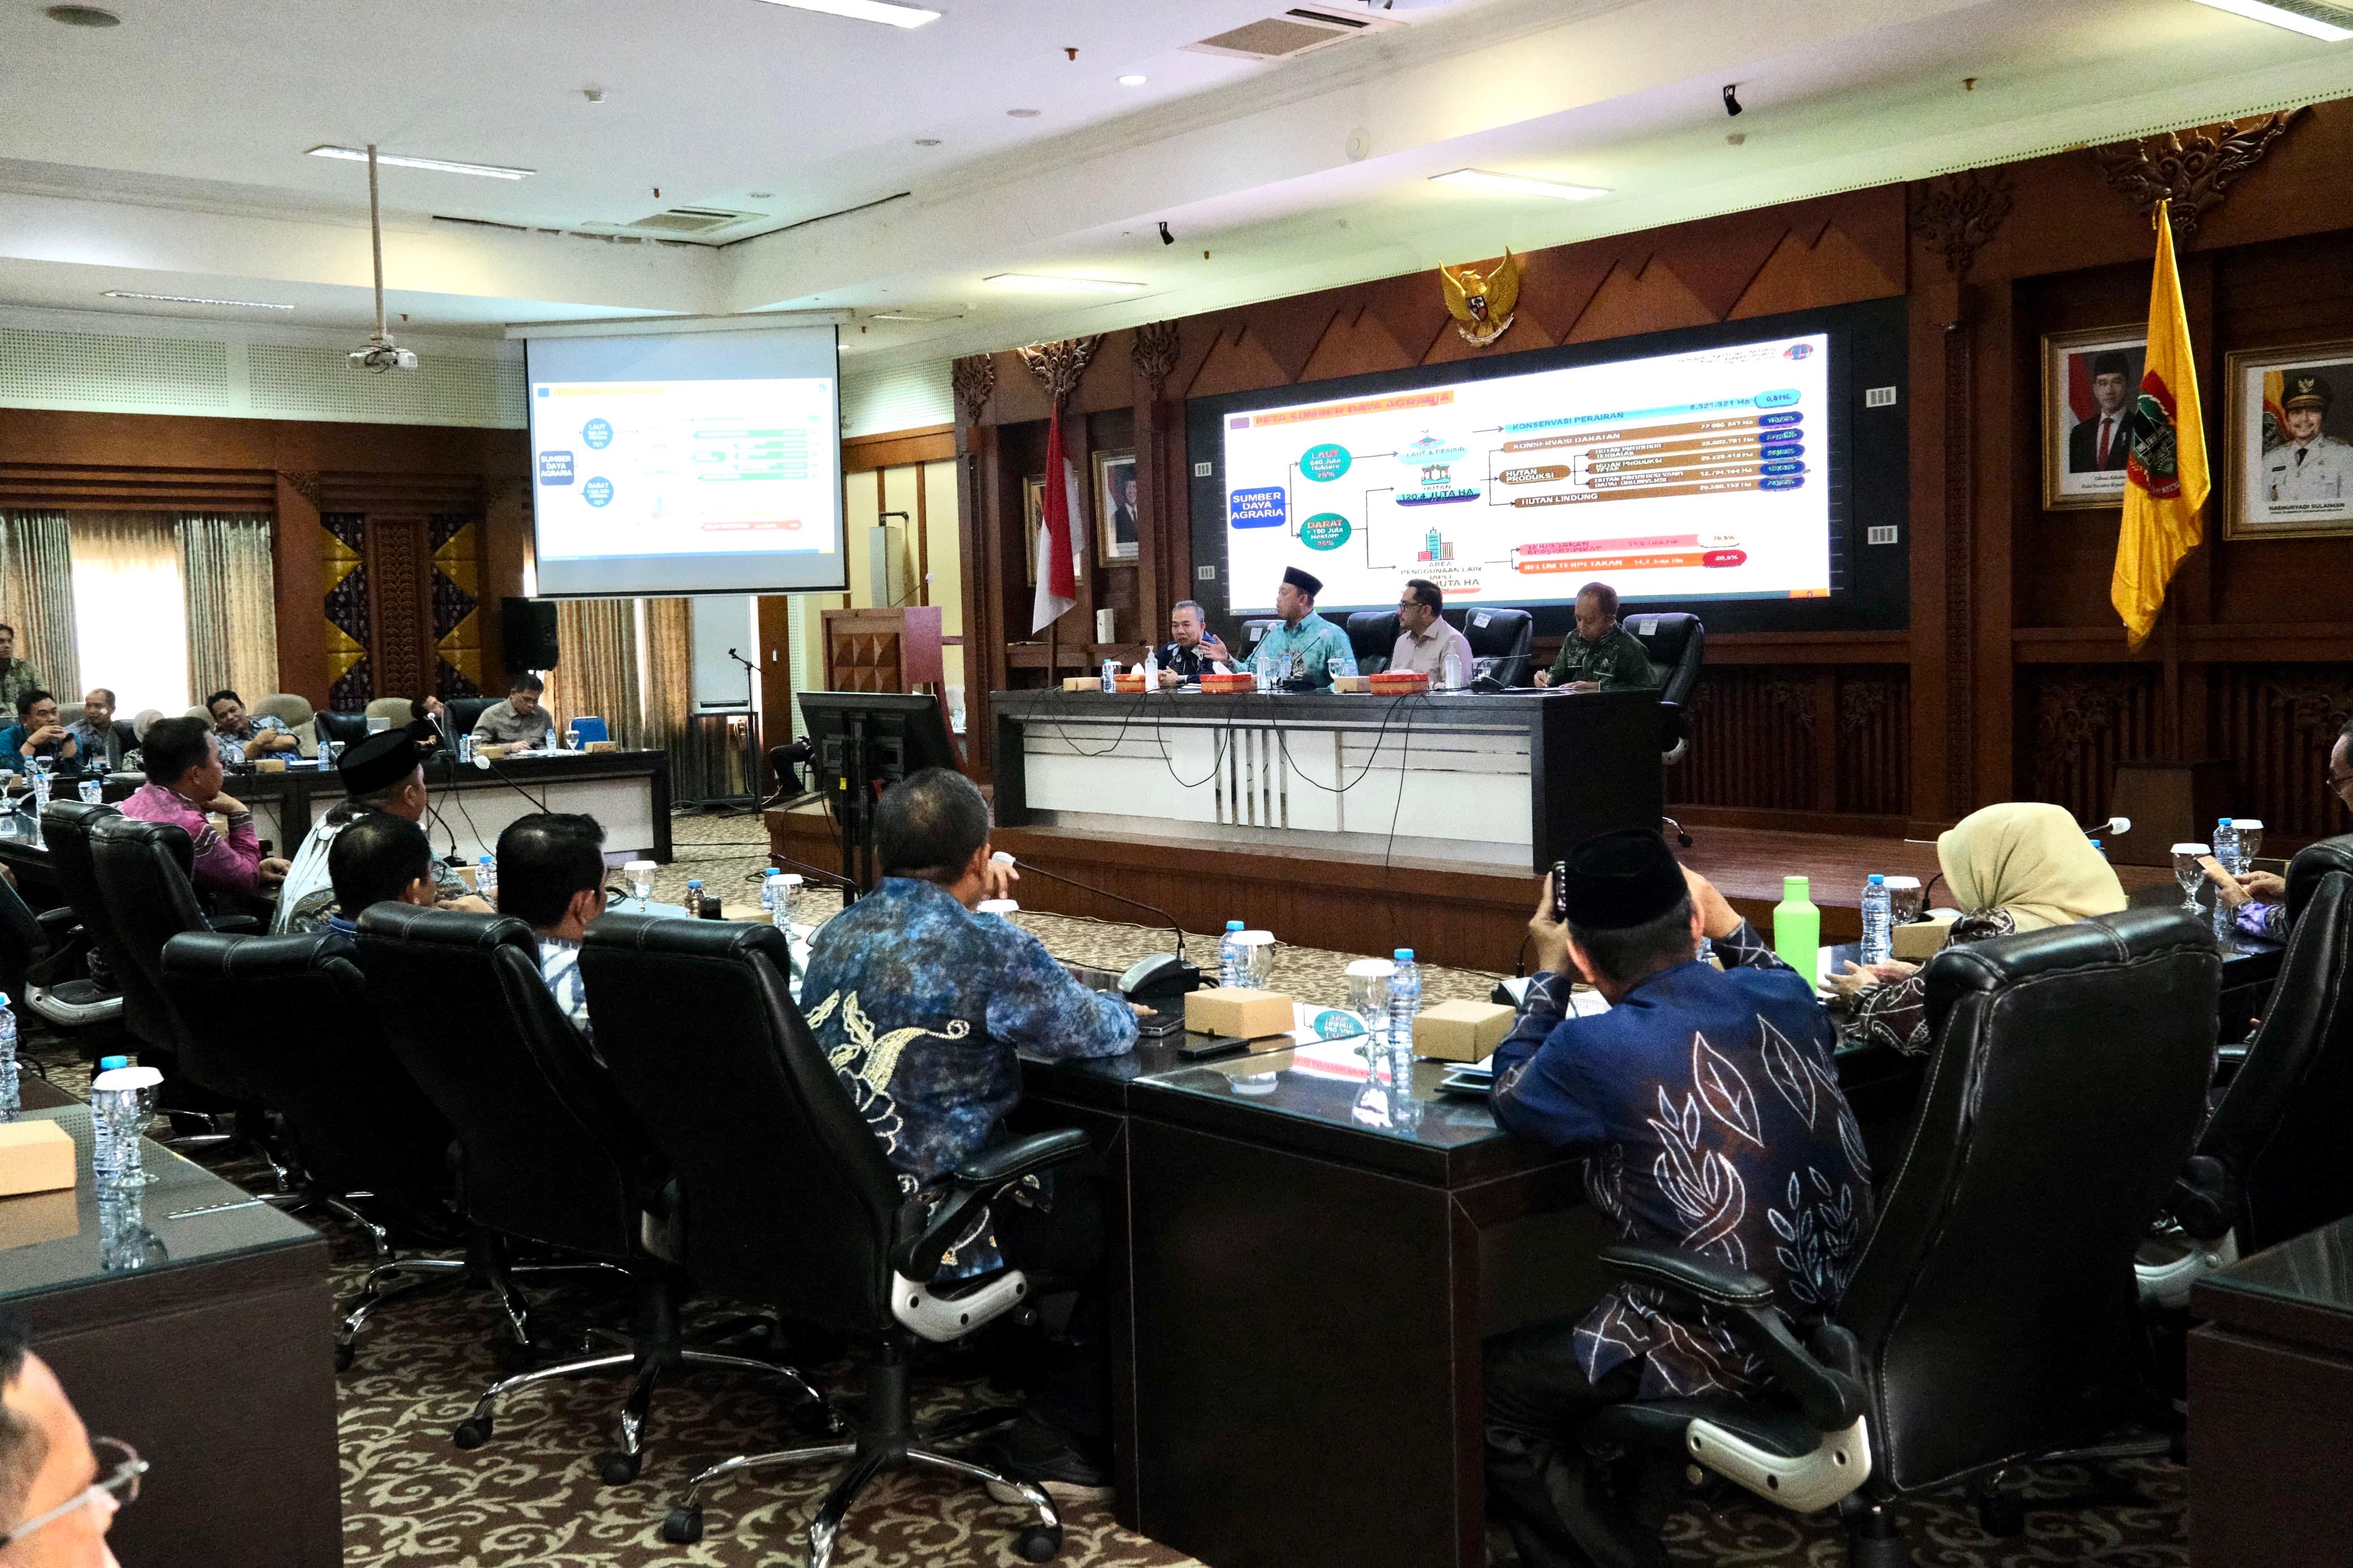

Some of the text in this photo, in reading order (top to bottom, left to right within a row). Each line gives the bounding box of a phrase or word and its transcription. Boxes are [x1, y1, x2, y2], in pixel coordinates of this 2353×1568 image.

[1256, 392, 1449, 425] PETA SUMBER DAYA AGRARIA
[1512, 418, 1572, 430] KONSERVASI
[1574, 412, 1624, 423] PERAIRAN
[1513, 438, 1572, 449] KONSERVASI
[1575, 433, 1621, 443] DARATAN
[541, 455, 571, 463] SUMBER
[1311, 449, 1341, 459] LAUT
[1506, 469, 1537, 477] HUTAN
[1506, 473, 1554, 482] PRODUKSI
[1233, 492, 1281, 503] SUMBER
[1429, 490, 1456, 499] JUTA
[1522, 496, 1554, 506] HUTAN
[1555, 493, 1598, 503] LINDUNG
[1242, 501, 1272, 510] DAYA
[1231, 508, 1284, 520] AGRARIA
[1308, 519, 1343, 529] DARAT
